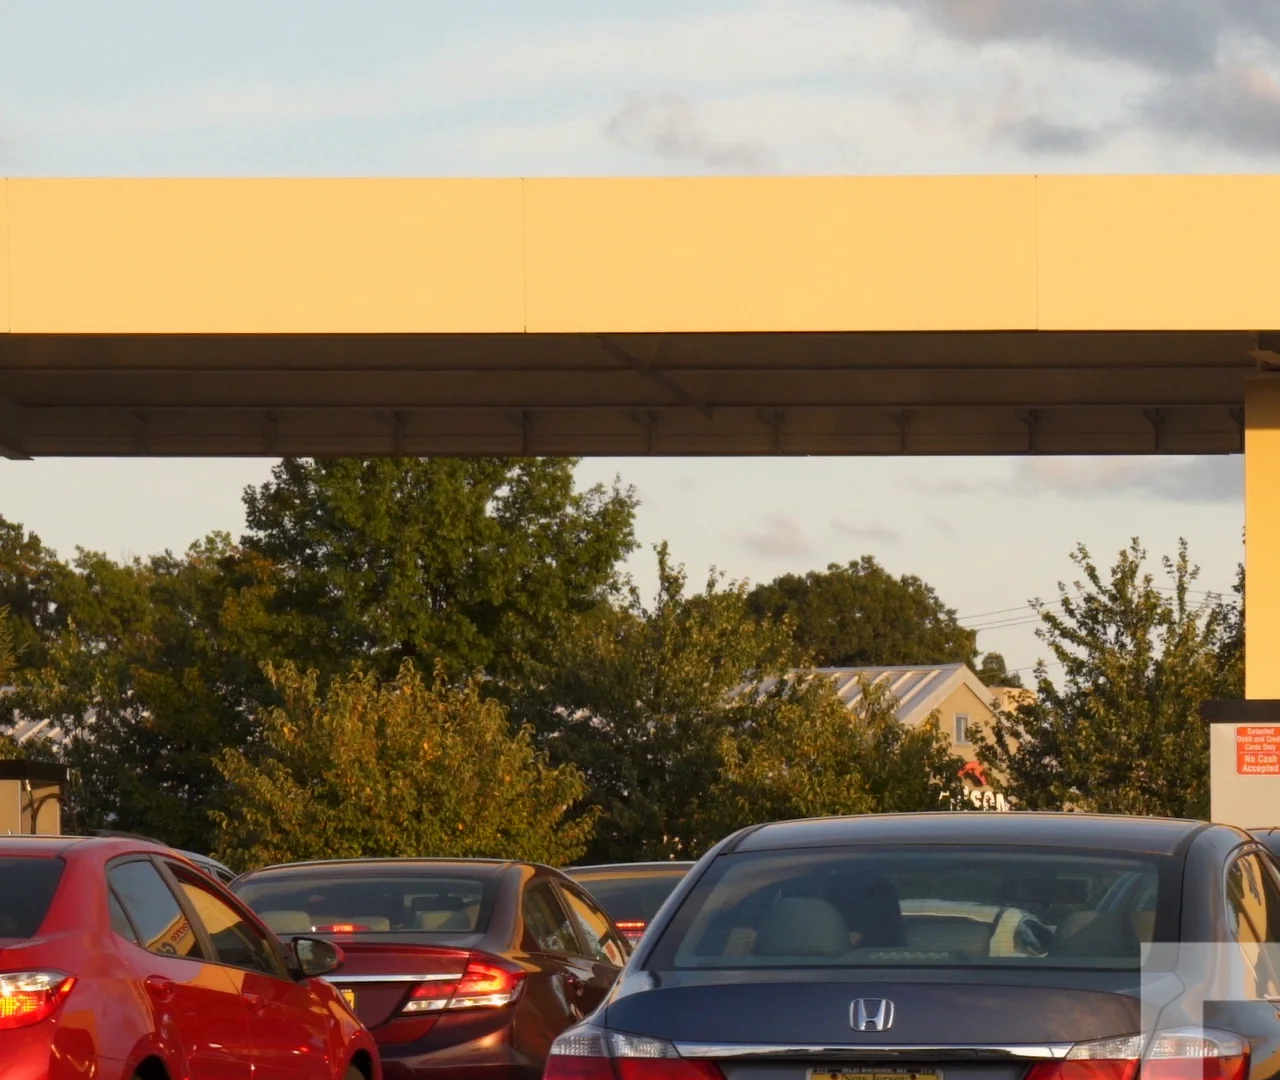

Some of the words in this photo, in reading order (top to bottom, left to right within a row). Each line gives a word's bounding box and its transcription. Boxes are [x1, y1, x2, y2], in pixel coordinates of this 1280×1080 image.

[1244, 755, 1256, 763] No
[1257, 755, 1278, 763] Cash
[1242, 764, 1280, 774] Accepted
